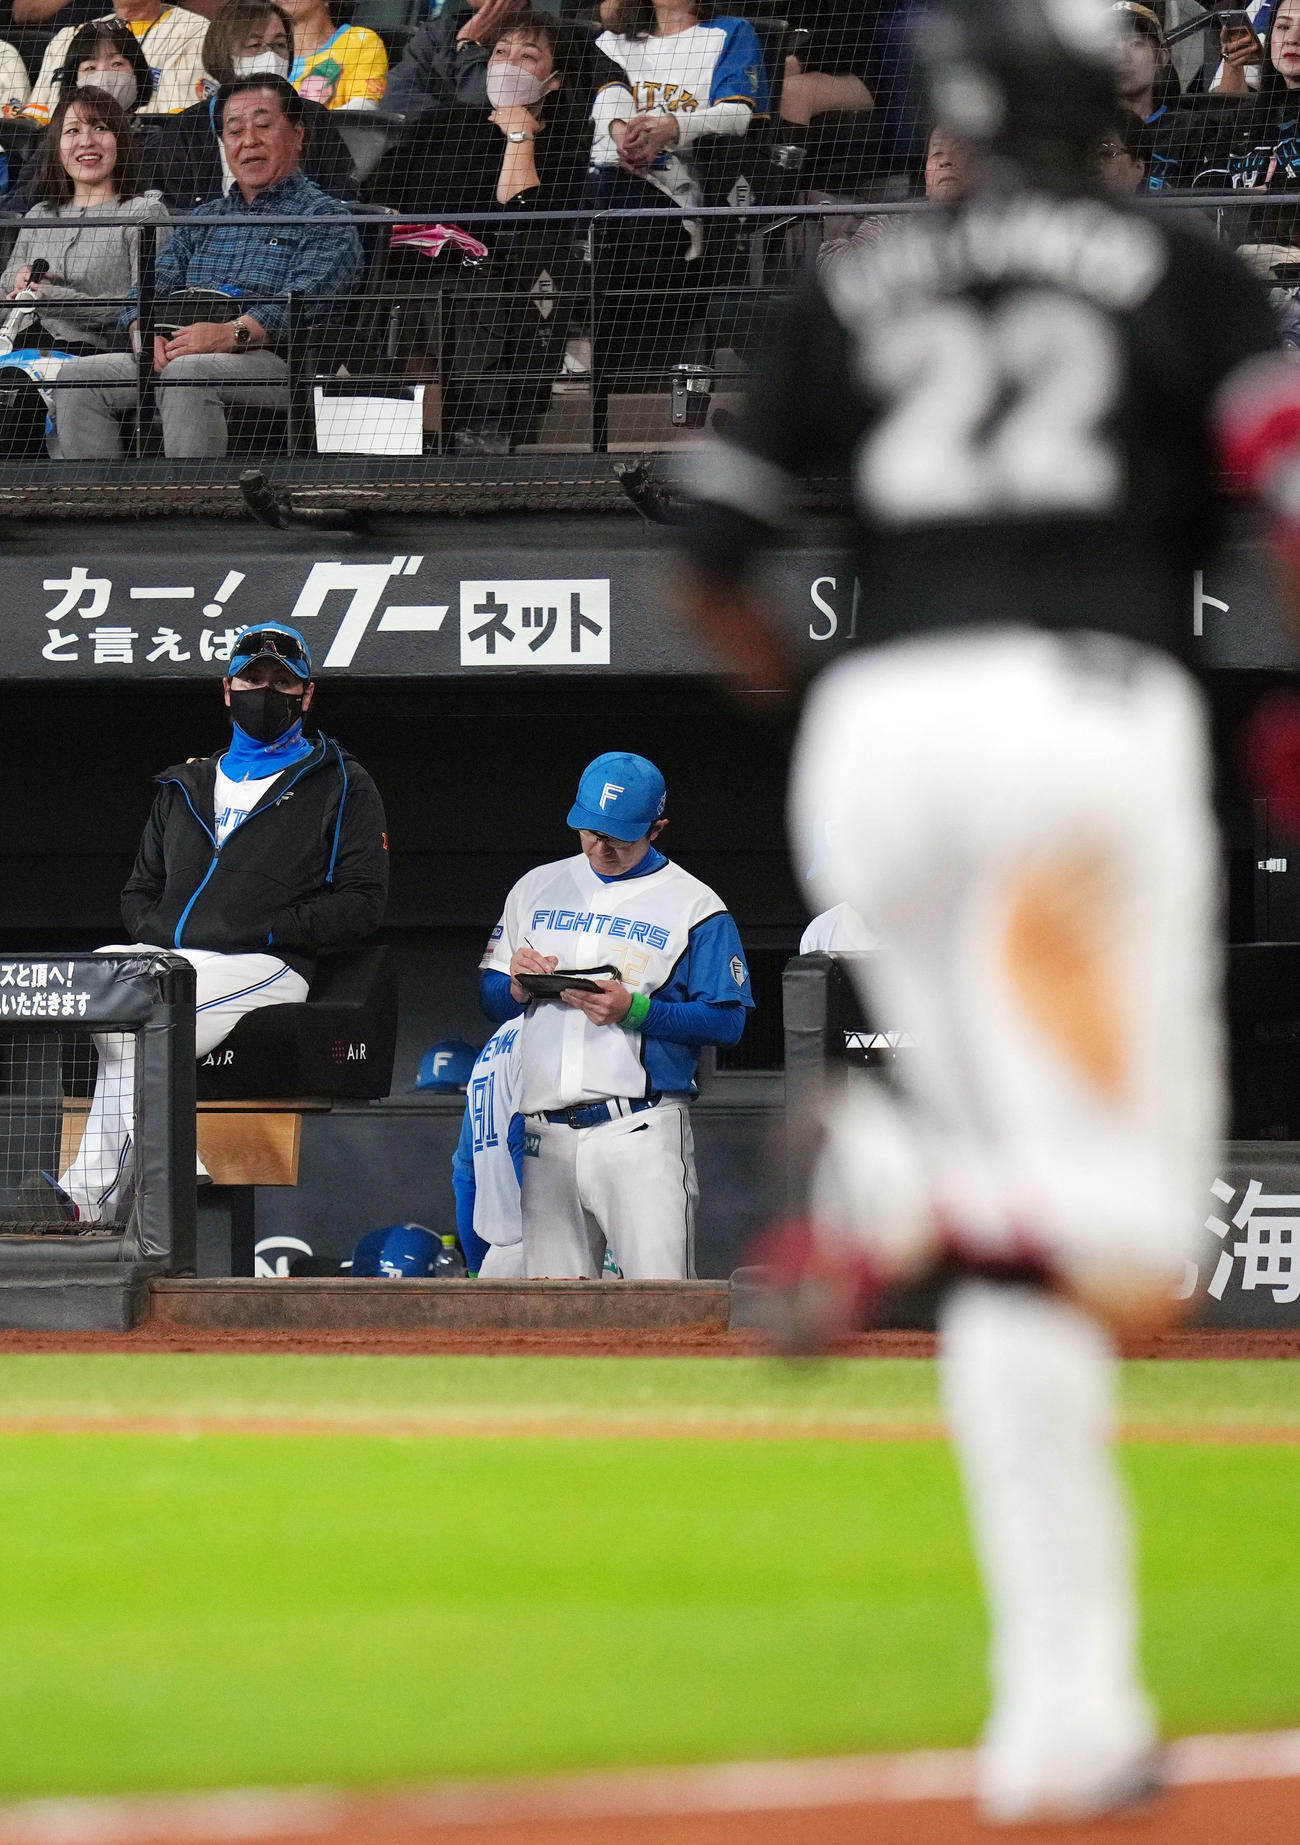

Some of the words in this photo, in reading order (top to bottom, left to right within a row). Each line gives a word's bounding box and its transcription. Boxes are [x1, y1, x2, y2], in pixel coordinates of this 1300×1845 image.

[858, 300, 1118, 516] 22
[43, 567, 246, 621] カー!
[468, 591, 602, 654] ネット
[42, 625, 248, 663] と言えば
[599, 782, 625, 811] F
[532, 910, 671, 950] FIGHTERS
[0, 962, 75, 988] ズと頂へ!
[1, 992, 91, 1016] いただきます
[432, 1051, 454, 1077] F
[1174, 1177, 1300, 1304] 海
